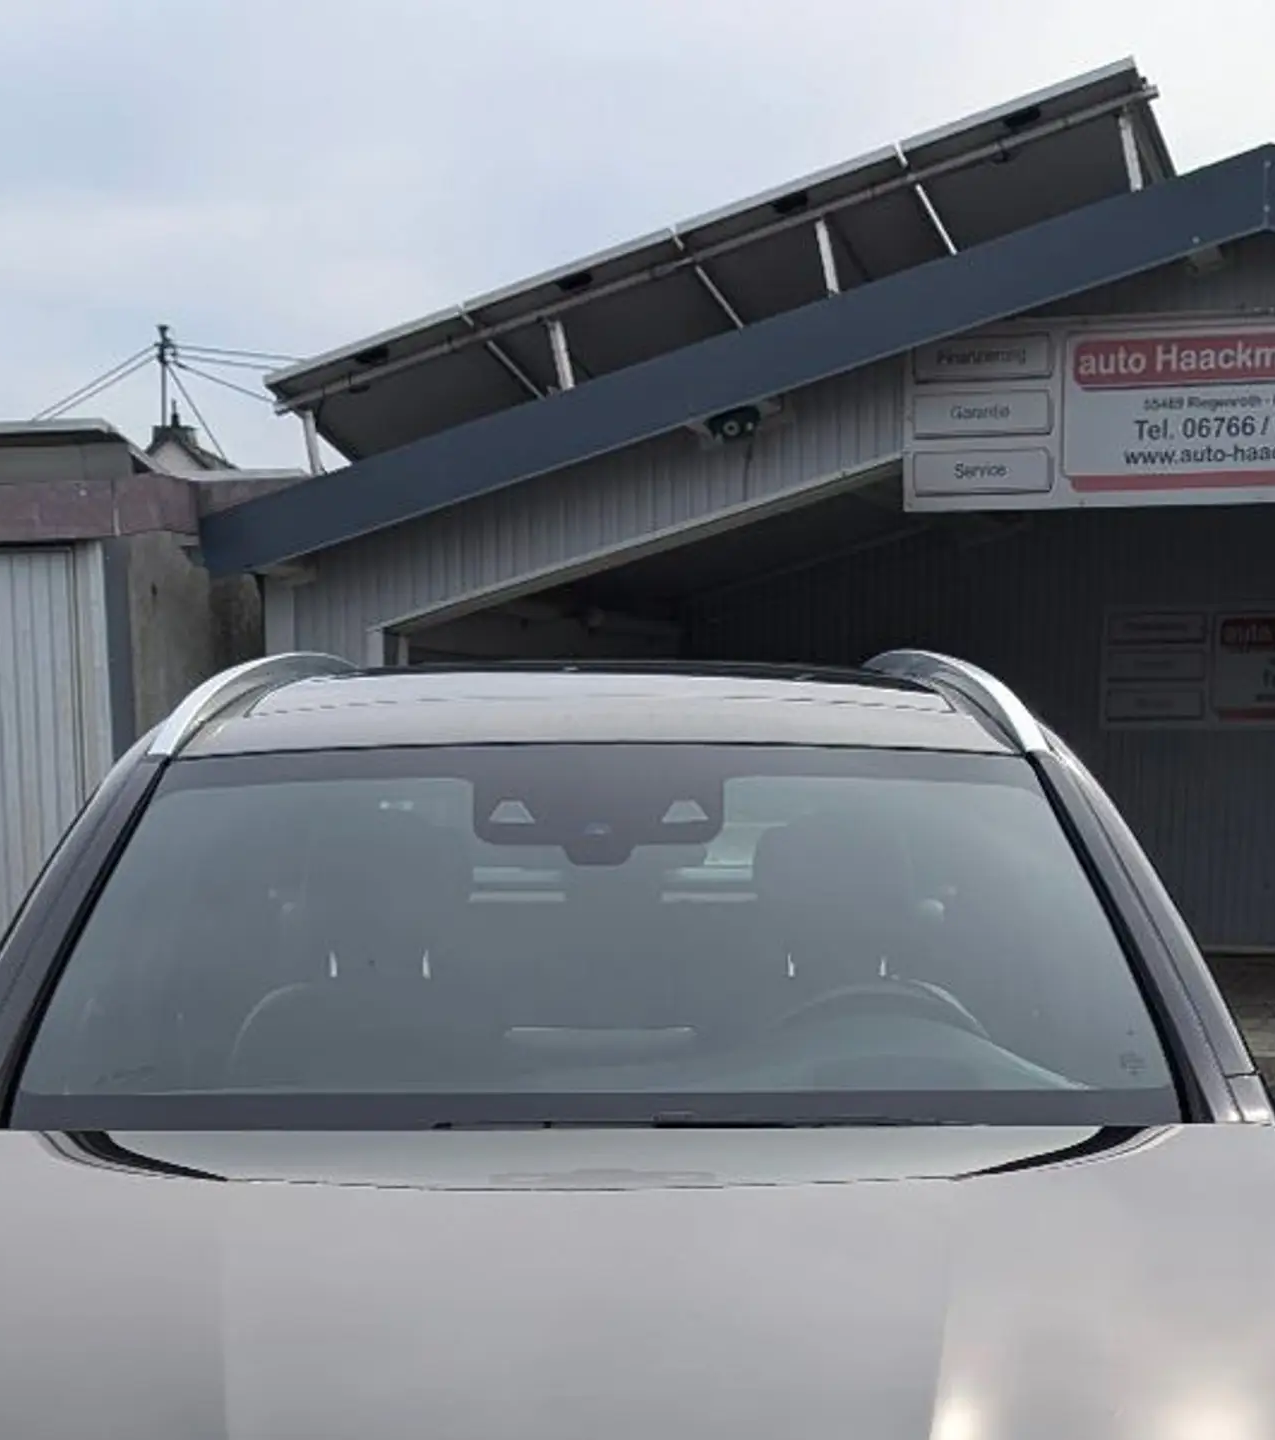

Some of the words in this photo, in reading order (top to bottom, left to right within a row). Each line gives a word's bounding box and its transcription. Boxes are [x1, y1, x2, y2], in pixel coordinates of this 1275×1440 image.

[1078, 348, 1146, 376] auto
[1186, 393, 1262, 412] Riegenroth
[949, 404, 1011, 421] Garantie
[1134, 417, 1174, 441] Tel.
[1180, 415, 1256, 439] 06766
[1259, 415, 1269, 437] /
[954, 462, 1007, 480] Service
